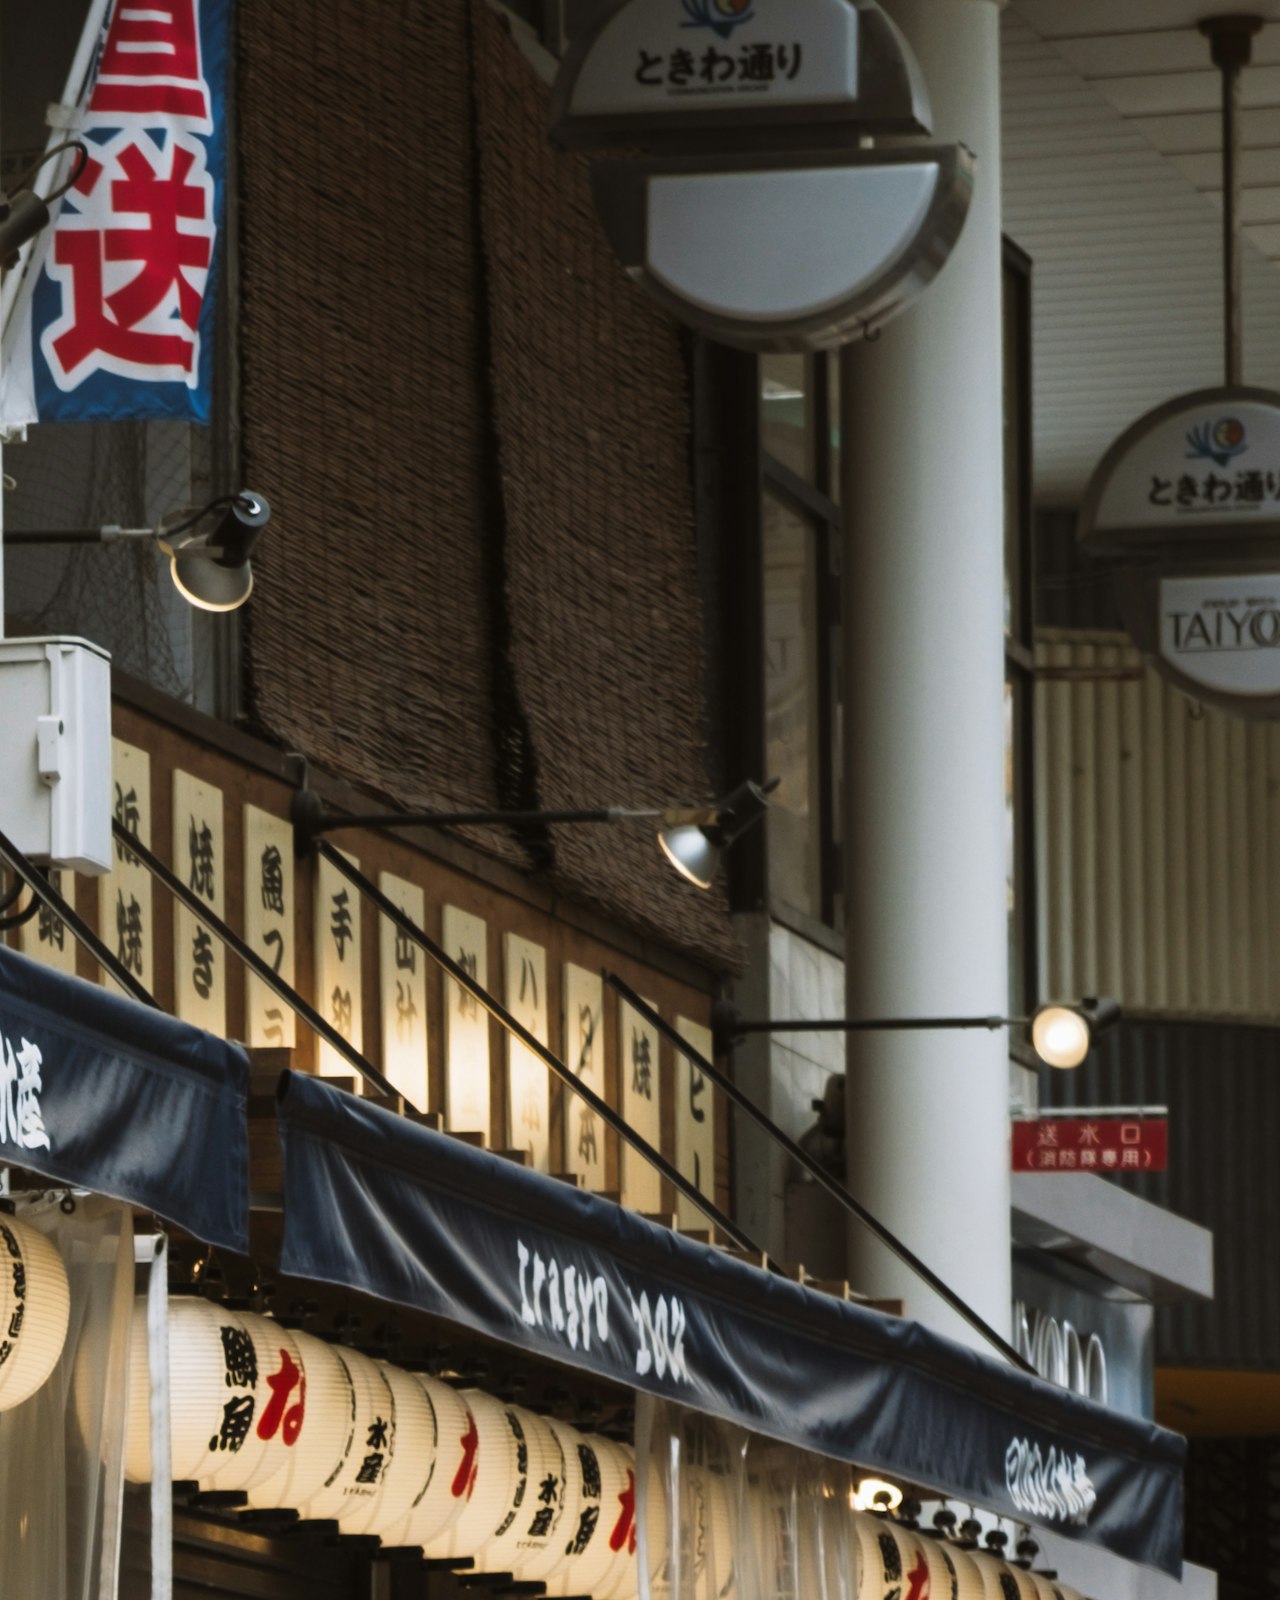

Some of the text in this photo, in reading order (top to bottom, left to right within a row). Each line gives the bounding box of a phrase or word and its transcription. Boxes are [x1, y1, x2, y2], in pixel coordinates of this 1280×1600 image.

[634, 42, 802, 87] ときわ通り
